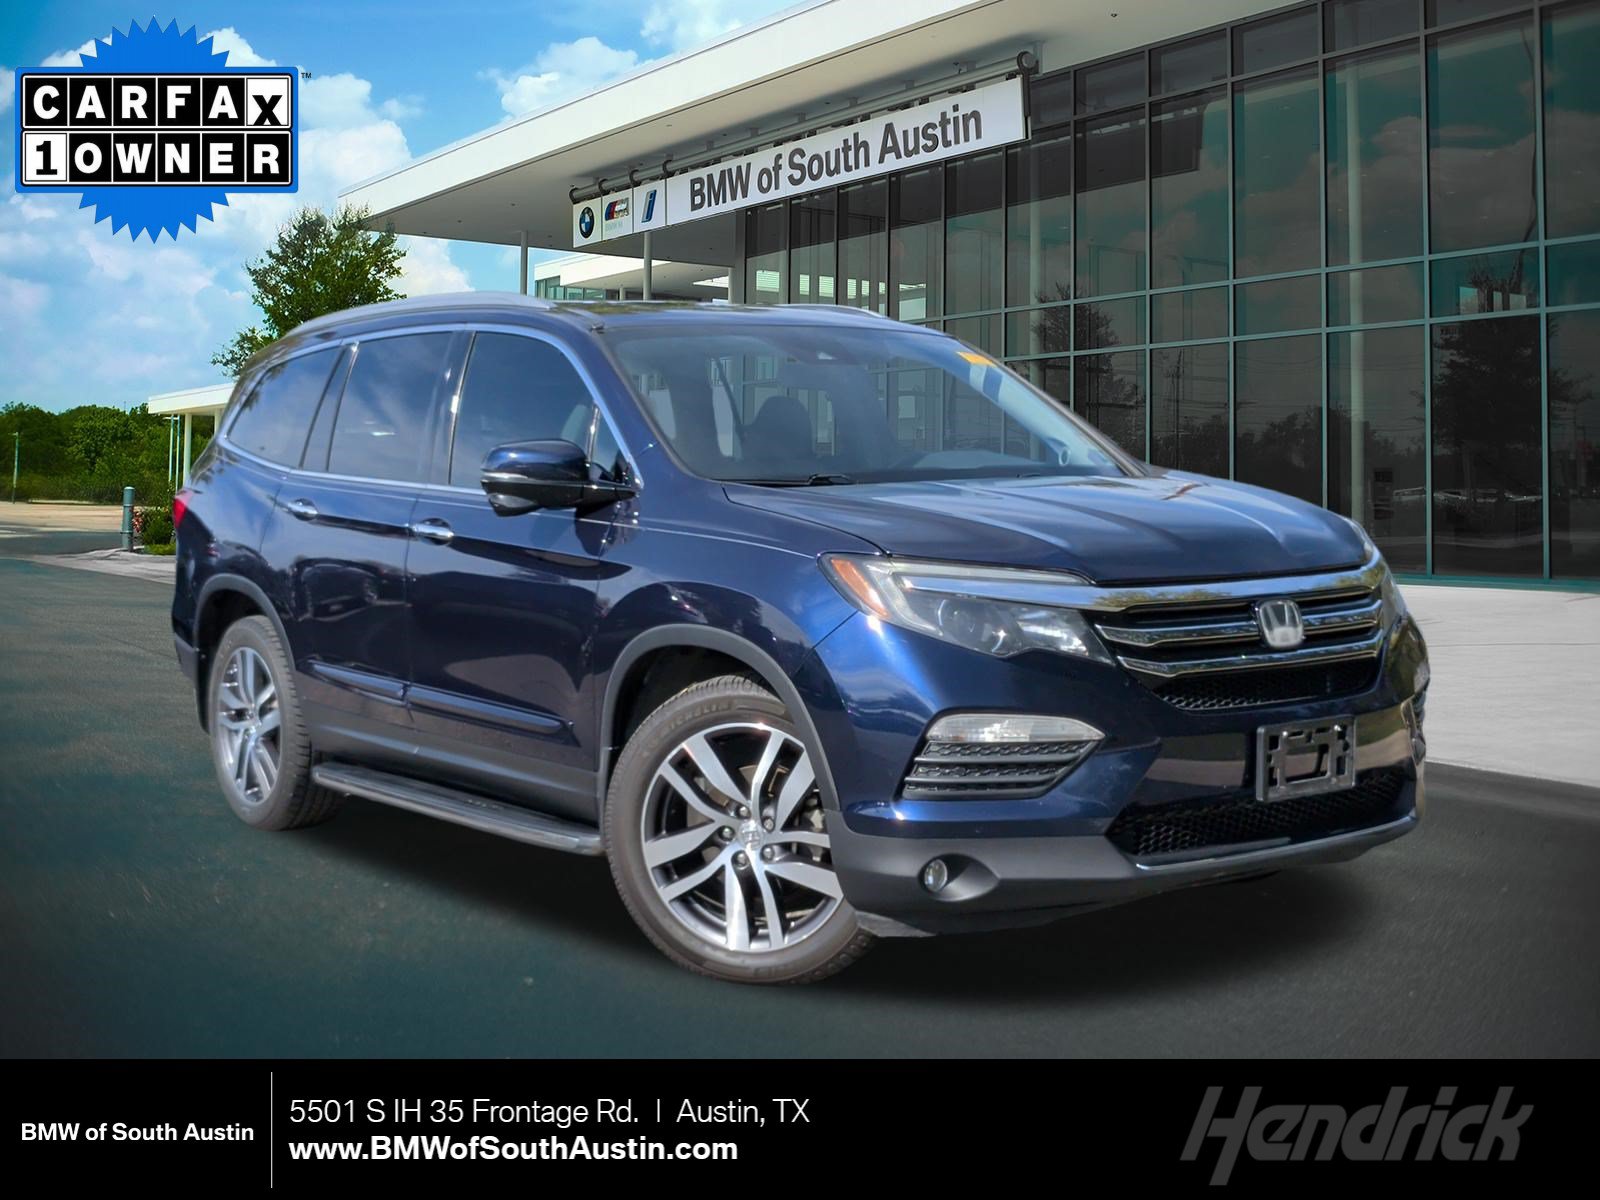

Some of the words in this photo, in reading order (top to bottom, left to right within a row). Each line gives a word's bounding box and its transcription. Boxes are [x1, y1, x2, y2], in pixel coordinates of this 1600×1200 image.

[689, 161, 752, 212] BMW
[757, 152, 783, 194] of
[787, 133, 871, 186] South
[878, 104, 983, 164] Austin
